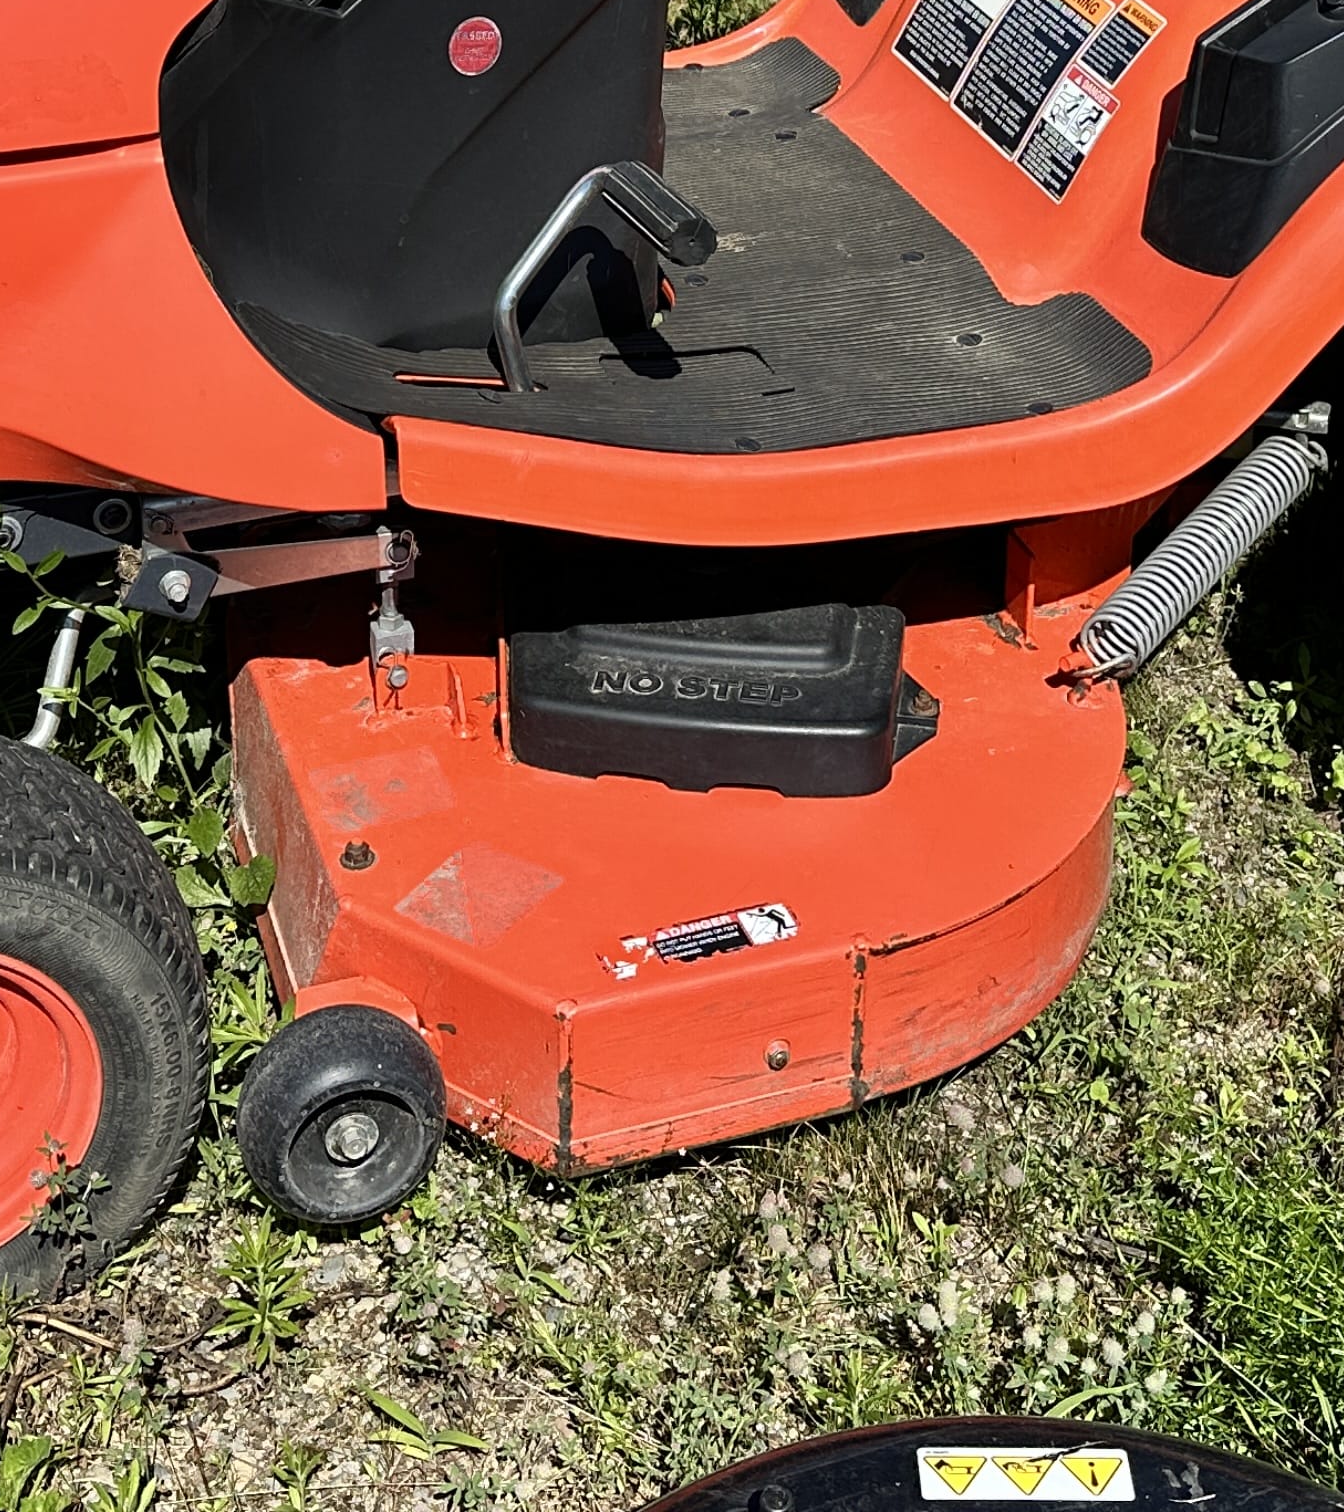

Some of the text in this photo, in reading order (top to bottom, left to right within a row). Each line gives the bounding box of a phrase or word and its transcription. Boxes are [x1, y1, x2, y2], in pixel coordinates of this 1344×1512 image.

[1131, 7, 1159, 32] WARNING
[1081, 78, 1111, 108] DANGER
[590, 671, 804, 707] NO STEP
[669, 914, 732, 935] DANGER
[150, 991, 183, 1149] 15X6.00-8 NHS
